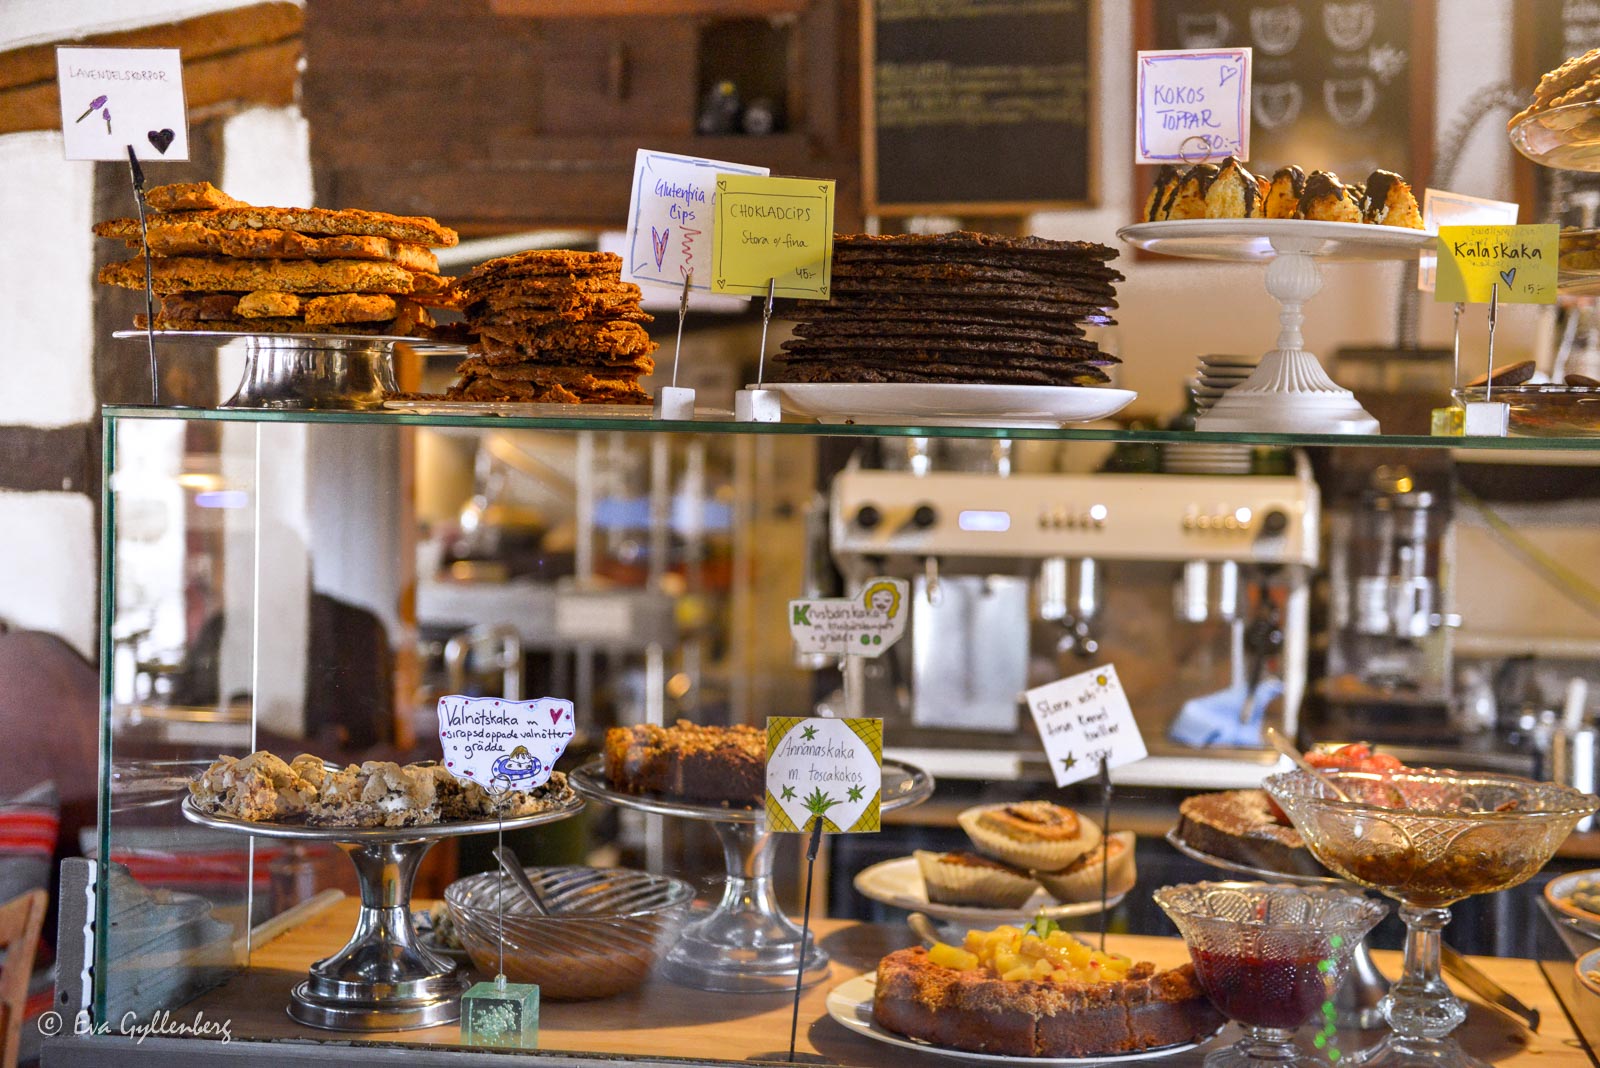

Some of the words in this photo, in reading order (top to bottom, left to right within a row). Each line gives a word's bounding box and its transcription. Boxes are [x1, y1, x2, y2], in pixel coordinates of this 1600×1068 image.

[1154, 85, 1205, 105] KOKOS
[1156, 109, 1221, 130] TOPPAR
[654, 178, 705, 207] Glutenfria
[742, 229, 769, 246] Stora
[782, 233, 808, 249] fina
[1454, 242, 1542, 260] Kalaskaka
[445, 704, 519, 727] Valnötskaka
[520, 729, 568, 739] valnötter
[465, 741, 506, 759] grädde
